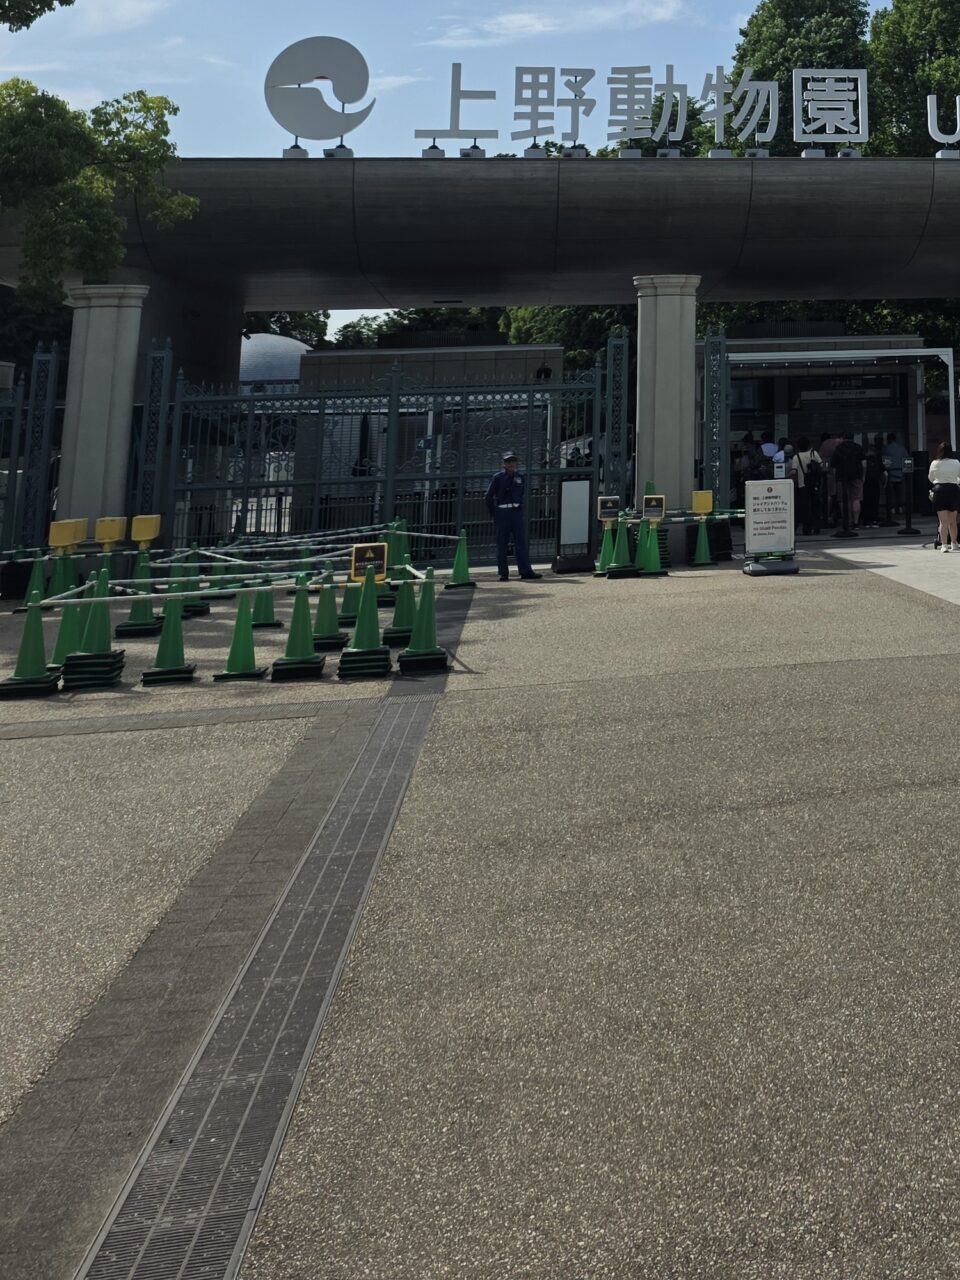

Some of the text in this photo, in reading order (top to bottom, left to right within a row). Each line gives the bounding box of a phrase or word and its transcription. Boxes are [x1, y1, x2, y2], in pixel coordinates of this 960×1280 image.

[414, 62, 869, 143] 上野動物園
